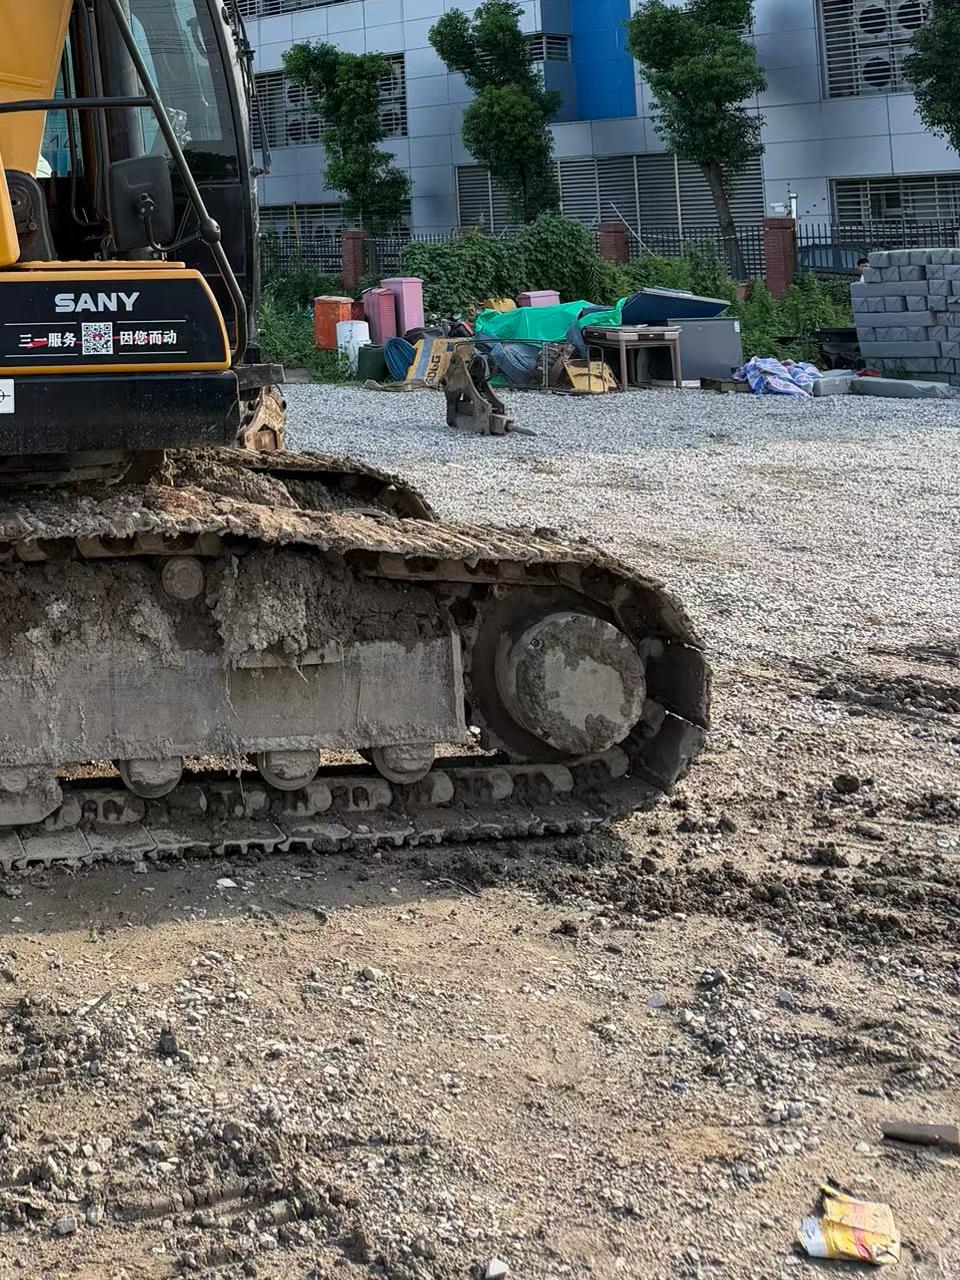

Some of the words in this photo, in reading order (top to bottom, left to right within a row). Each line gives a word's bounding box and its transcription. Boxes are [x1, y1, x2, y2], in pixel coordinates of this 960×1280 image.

[54, 292, 140, 313] SANY
[19, 332, 76, 348] 三一服务
[119, 330, 177, 346] 因您而动
